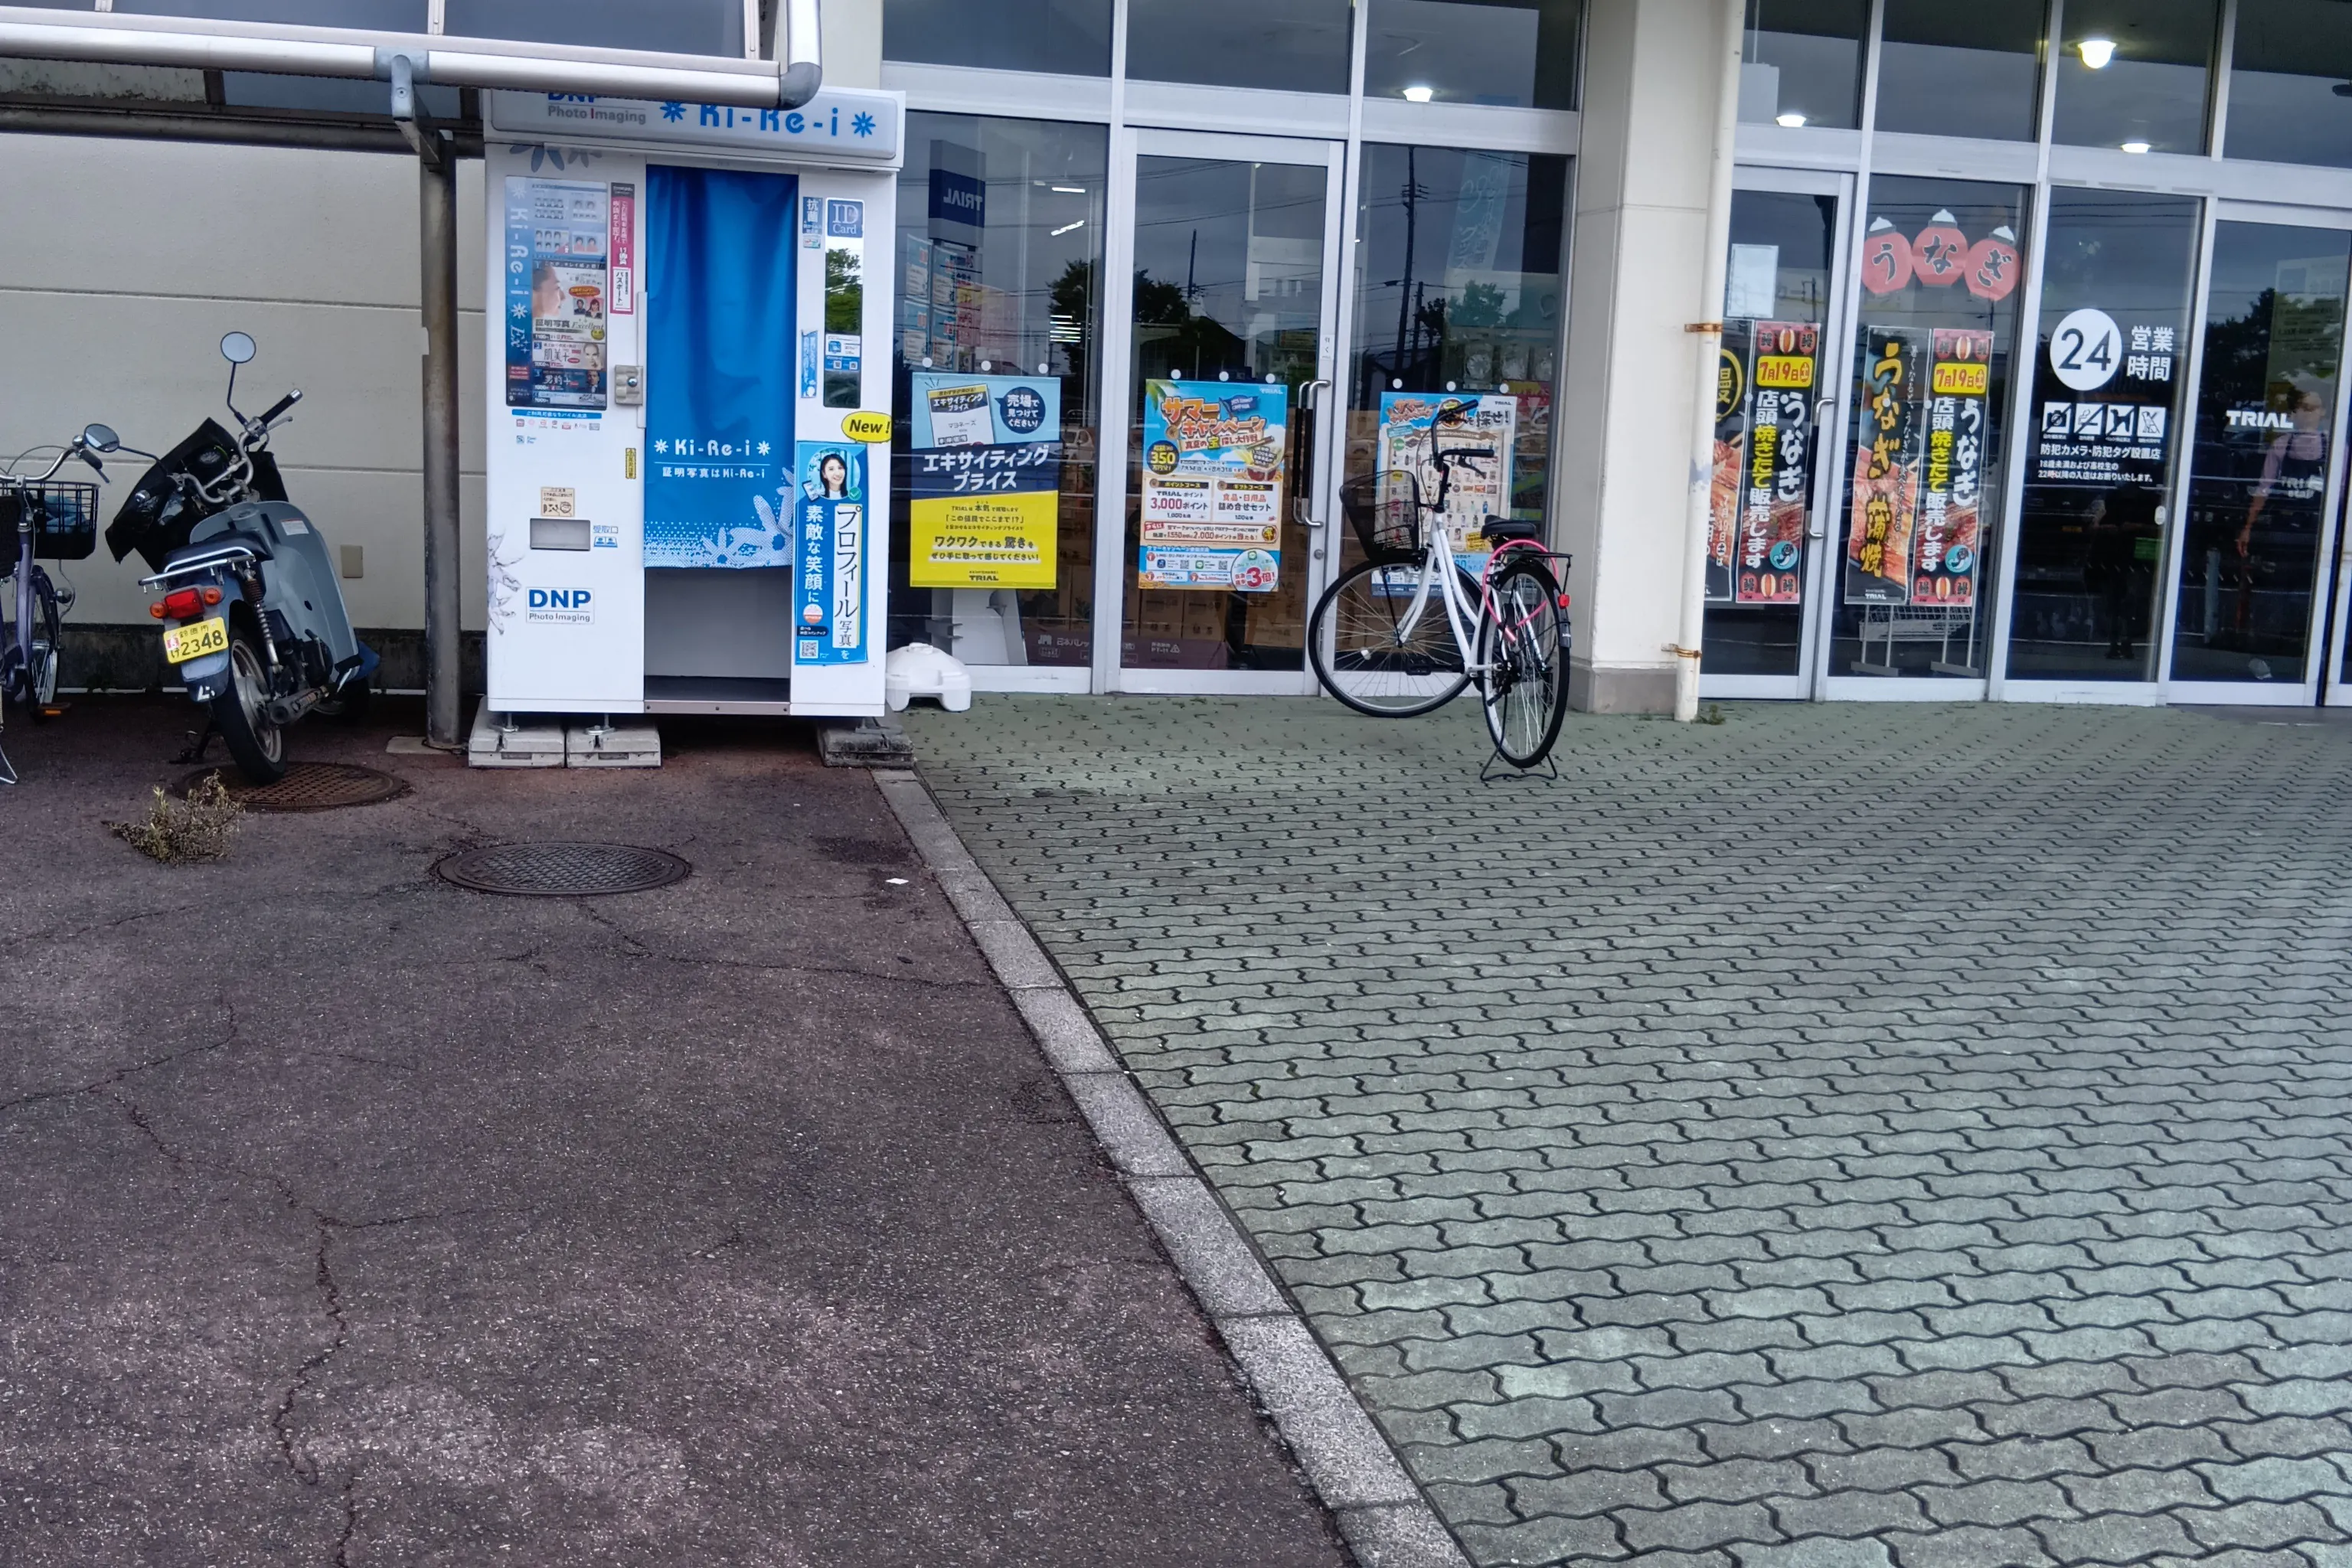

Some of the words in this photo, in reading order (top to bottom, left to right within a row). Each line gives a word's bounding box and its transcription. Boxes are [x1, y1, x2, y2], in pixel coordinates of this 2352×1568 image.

[547, 105, 588, 119] Photo
[590, 108, 646, 125] Imaging
[831, 203, 859, 224] ID
[832, 223, 857, 234] Card
[1872, 234, 2013, 287] うなぎ
[2131, 325, 2174, 352] 営業
[2057, 328, 2112, 371] 24
[2126, 354, 2171, 381] 時間
[933, 393, 984, 407] エキサイティング
[1007, 394, 1040, 409] 売場で
[1161, 395, 1221, 422] サマー
[1867, 341, 1903, 480] うなぎ
[1007, 409, 1039, 418] 見つけて
[2225, 409, 2294, 430] TRIAL
[948, 420, 978, 429] マヨネーズ
[1181, 415, 1267, 437] キャンペーン
[675, 439, 750, 456] Ki-Re-i
[923, 443, 1050, 472] エキサイティング
[1777, 391, 1806, 503] うなぎ
[1952, 398, 1981, 508] うなぎ
[2040, 443, 2162, 459] 防犯カメラ・防犯タグ設置店
[1150, 451, 1176, 465] 350
[953, 470, 1018, 492] プライス
[1746, 390, 1780, 570] 店頭焼きたて販売します
[1920, 397, 1956, 573] 店頭焼きたて販売します
[1150, 497, 1209, 511] 3,000ポイント
[593, 524, 619, 534] 受取口
[805, 505, 824, 603] 素敵な笑顔に
[528, 589, 592, 609] DNP
[529, 612, 554, 621] Photo
[555, 613, 591, 623] Imaging
[181, 629, 224, 656] 2348
